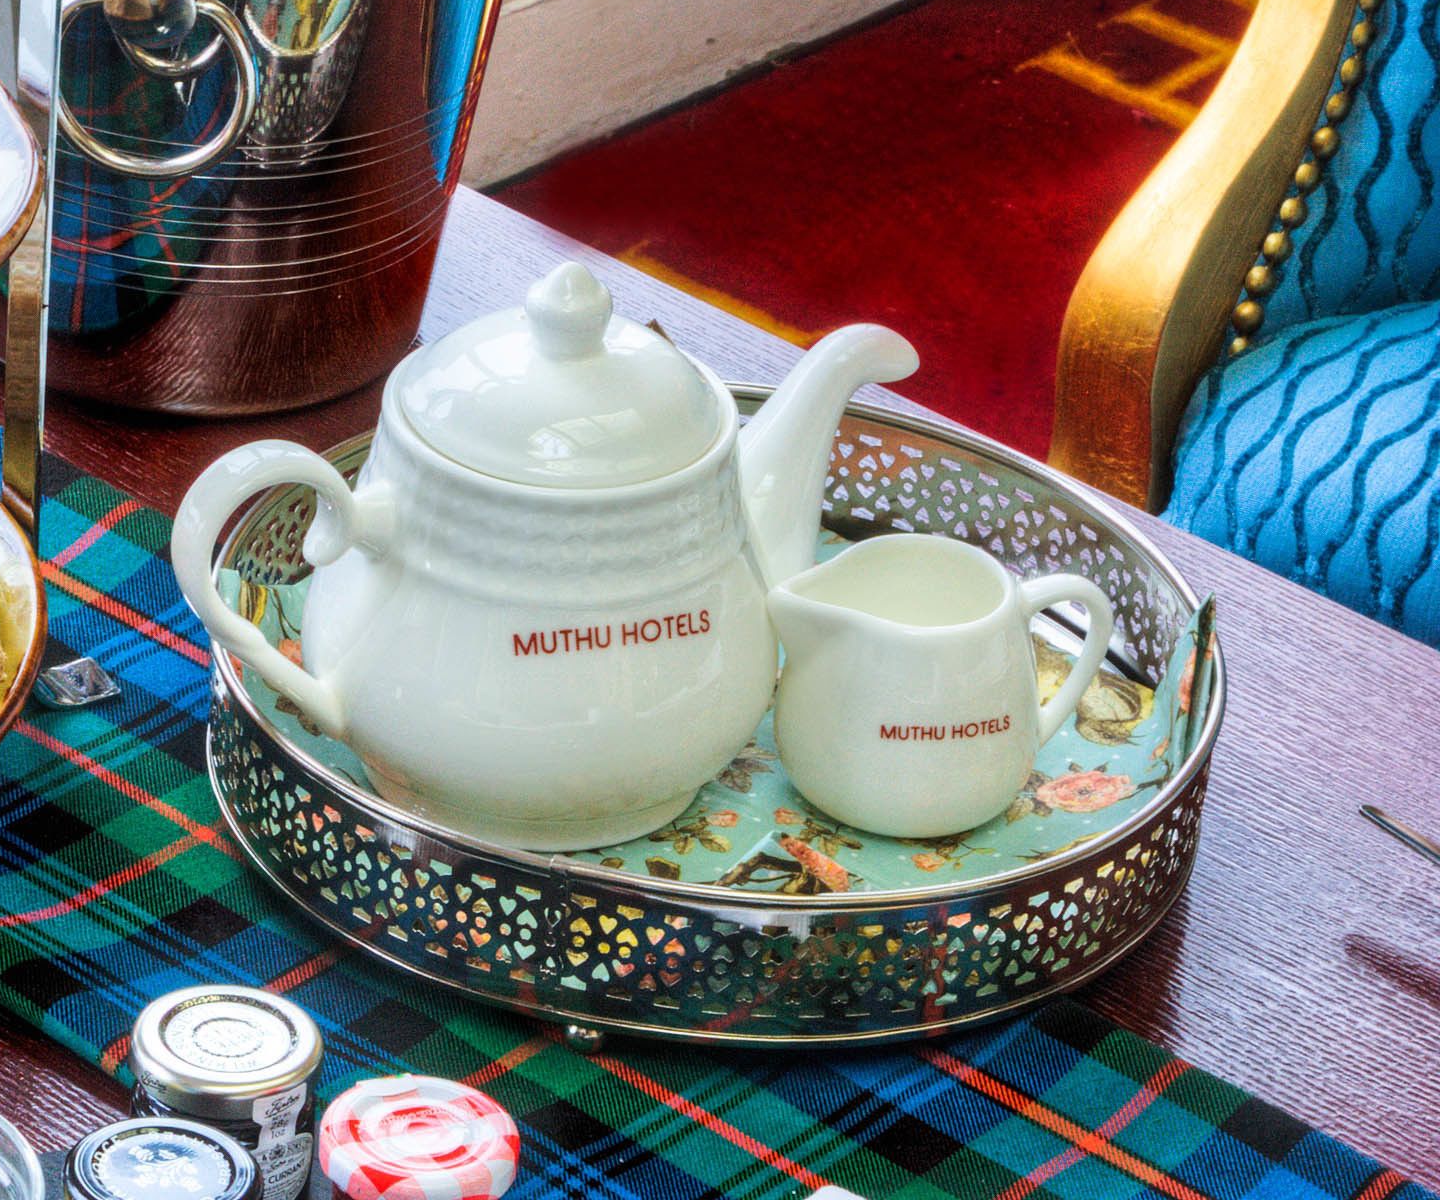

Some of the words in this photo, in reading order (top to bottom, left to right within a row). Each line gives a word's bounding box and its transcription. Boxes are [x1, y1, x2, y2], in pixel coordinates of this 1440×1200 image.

[512, 622, 612, 657] MUTHU
[621, 609, 712, 646] HOTELS
[879, 723, 946, 742] MUTHU
[952, 714, 1011, 740] HOTELS
